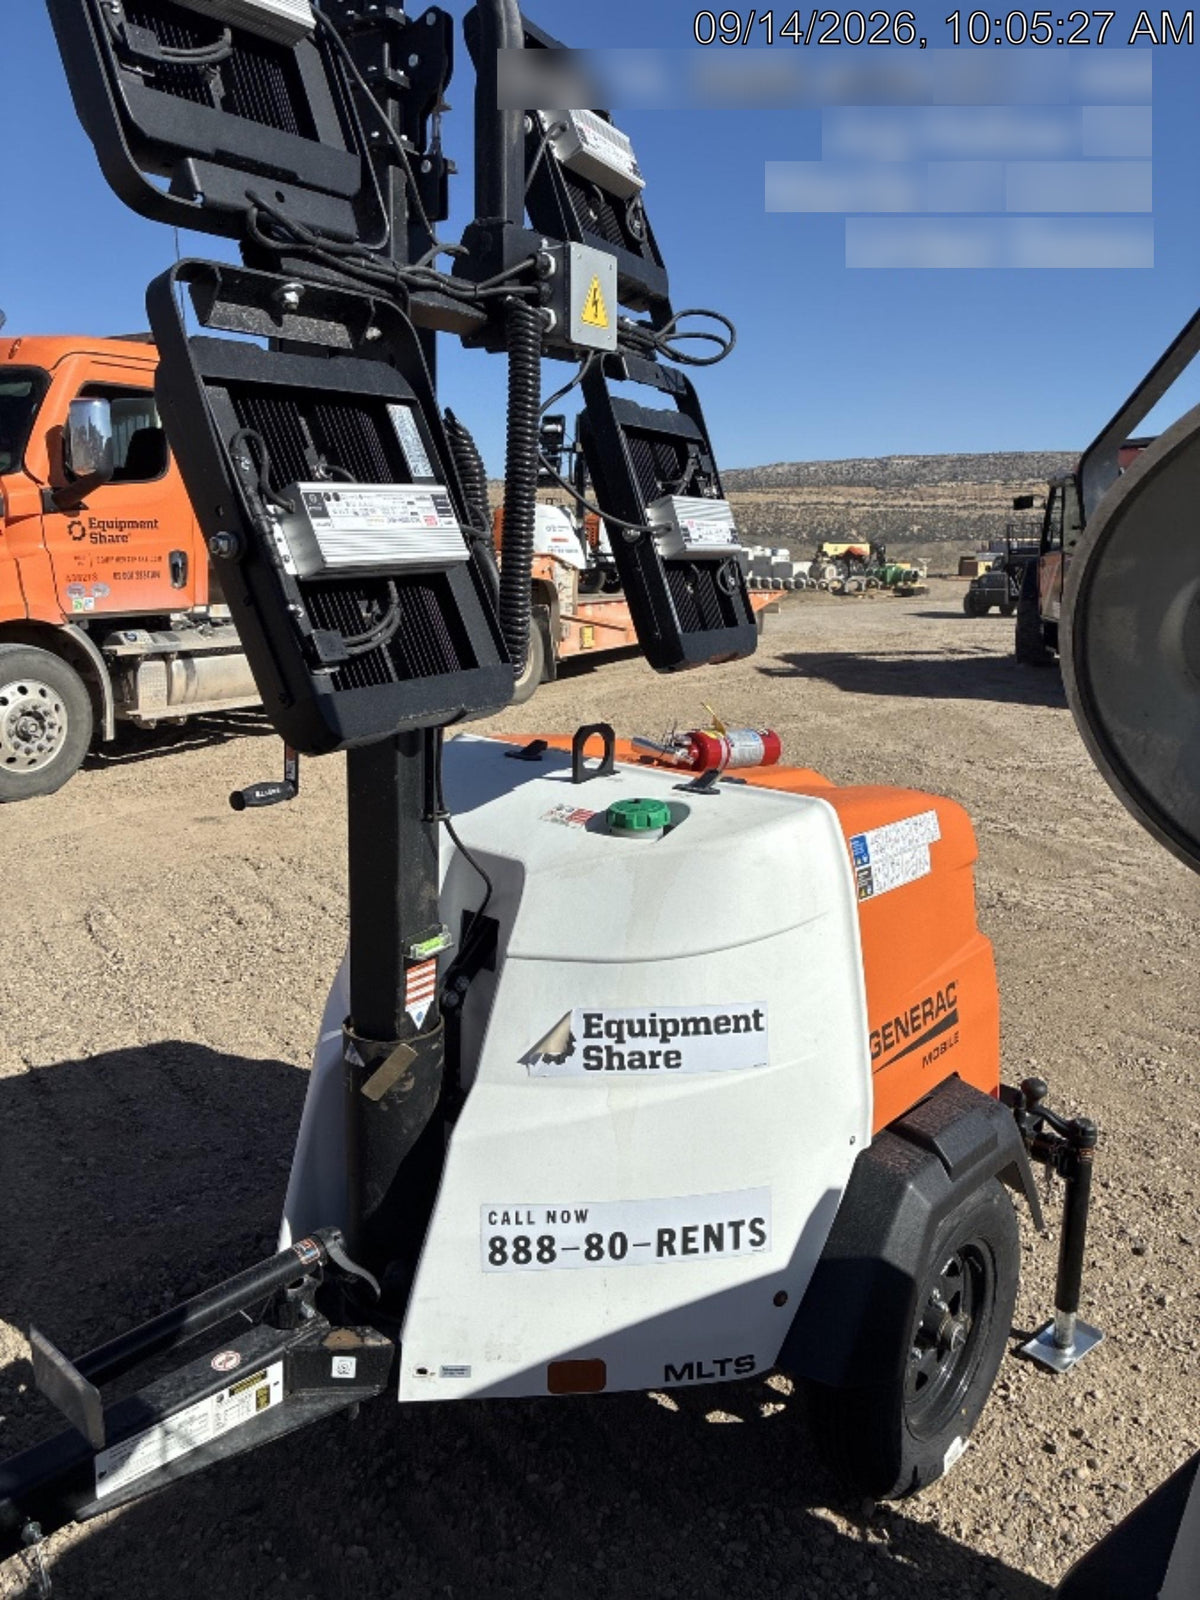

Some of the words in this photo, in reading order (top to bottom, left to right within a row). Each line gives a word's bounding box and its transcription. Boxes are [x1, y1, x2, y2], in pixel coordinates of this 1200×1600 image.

[88, 517, 159, 532] Equipment
[89, 532, 129, 545] Share
[582, 1008, 765, 1044] Equipment
[869, 981, 958, 1060] GENERAC
[582, 1045, 682, 1071] Share
[922, 1031, 959, 1069] MOBILE
[488, 1211, 536, 1226] CALL
[546, 1209, 589, 1224] NOW
[664, 1354, 756, 1382] MLTS
